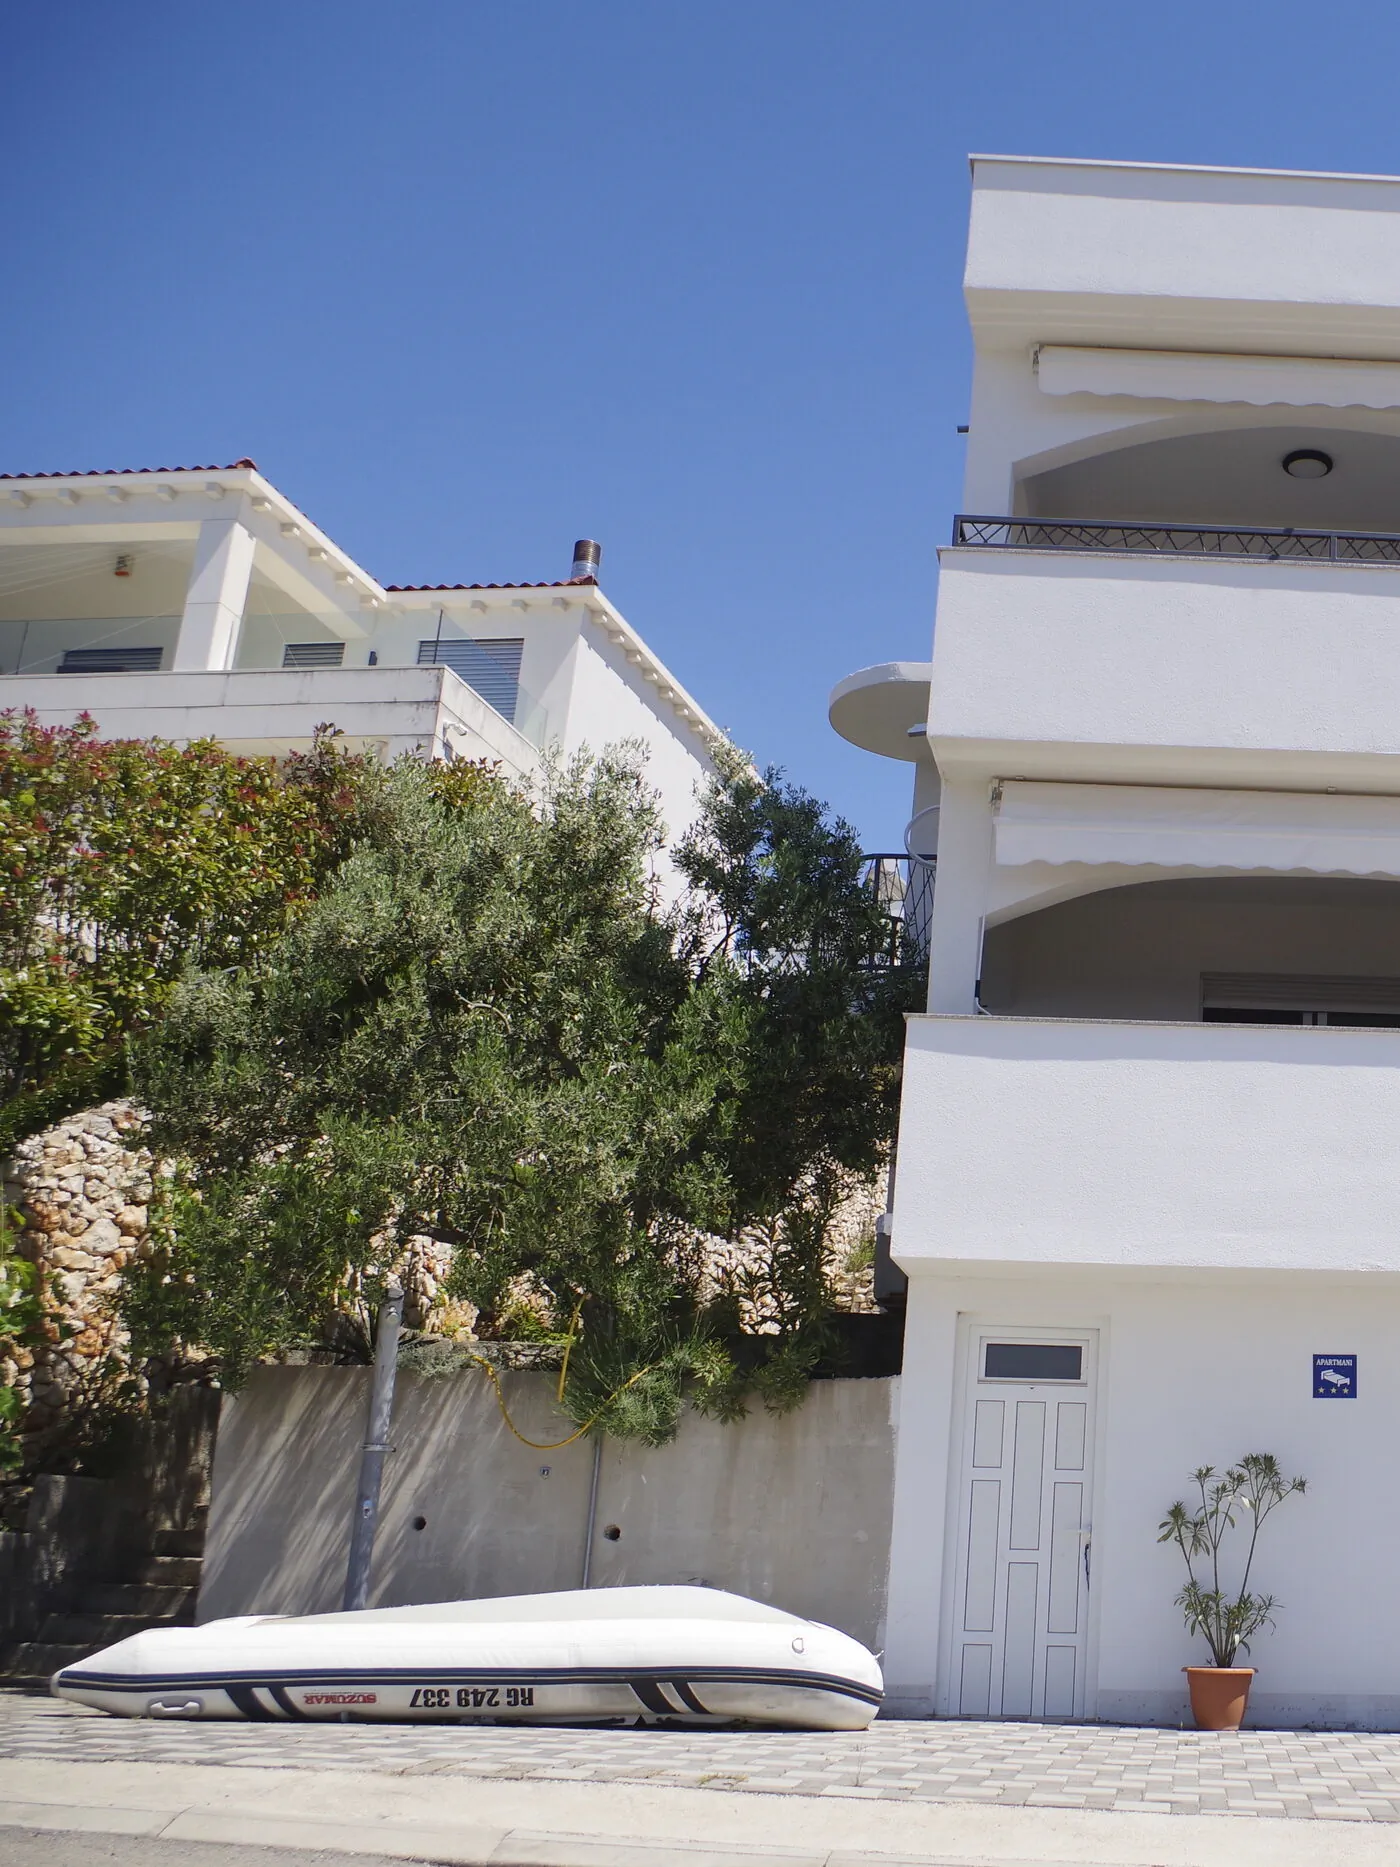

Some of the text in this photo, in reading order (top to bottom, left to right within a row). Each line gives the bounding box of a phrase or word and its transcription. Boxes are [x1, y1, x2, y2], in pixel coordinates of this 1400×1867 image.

[1316, 1358, 1353, 1366] APARTMANI
[303, 1694, 378, 1705] SUZUMAR
[409, 1687, 535, 1708] RG 249 337
